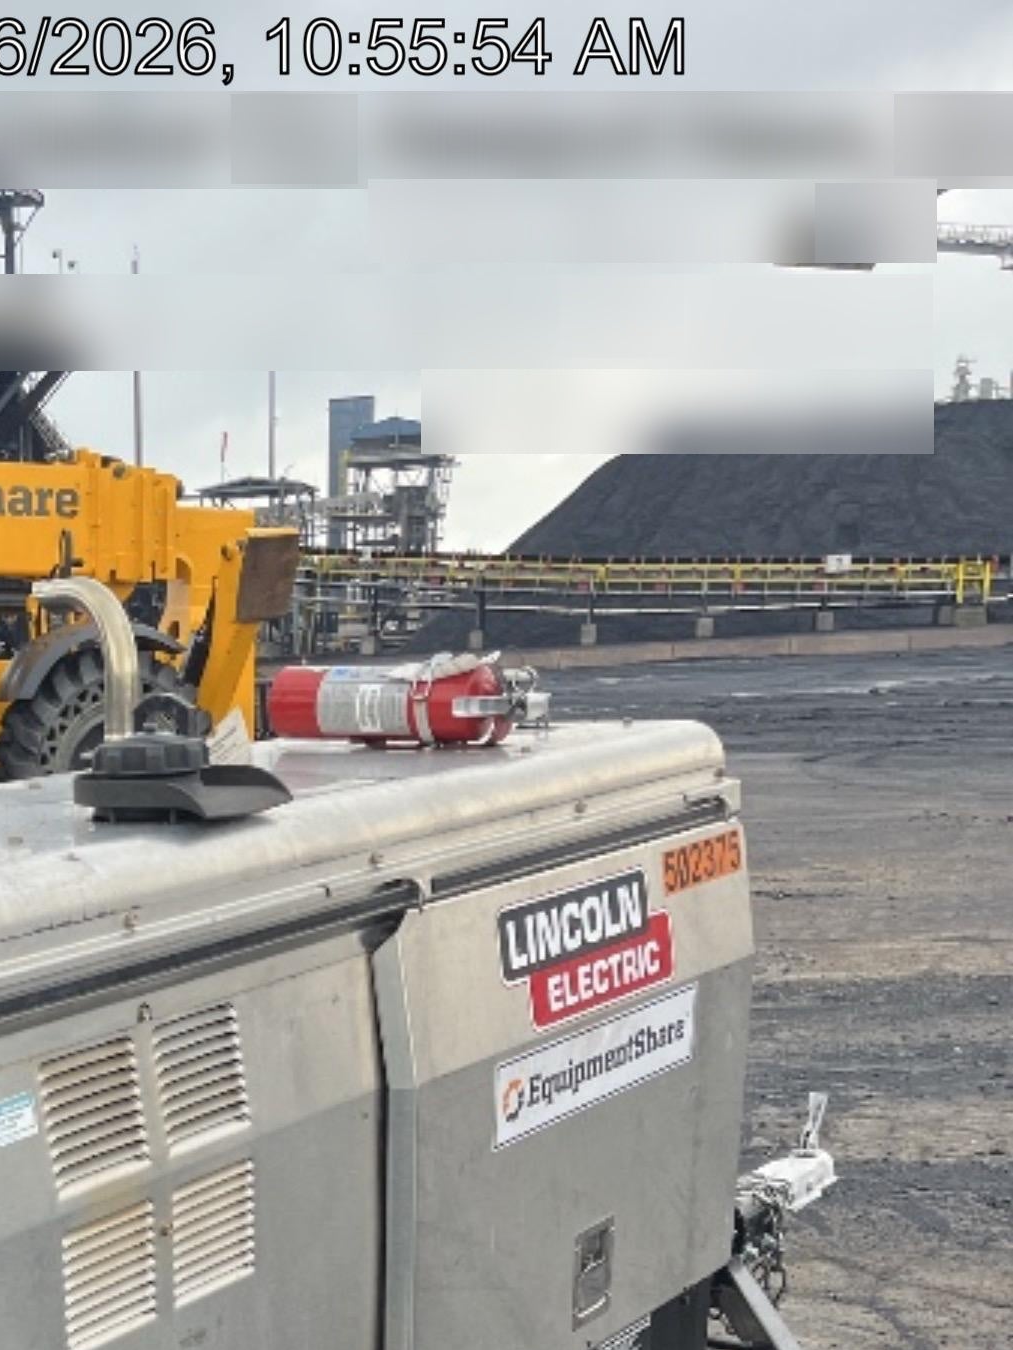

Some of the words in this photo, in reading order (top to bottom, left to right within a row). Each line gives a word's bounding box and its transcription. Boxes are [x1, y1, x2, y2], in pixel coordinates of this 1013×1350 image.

[505, 880, 643, 970] LINCOLN
[546, 940, 662, 1013] ELECTRIC
[527, 1018, 686, 1107] EquipmentShare
